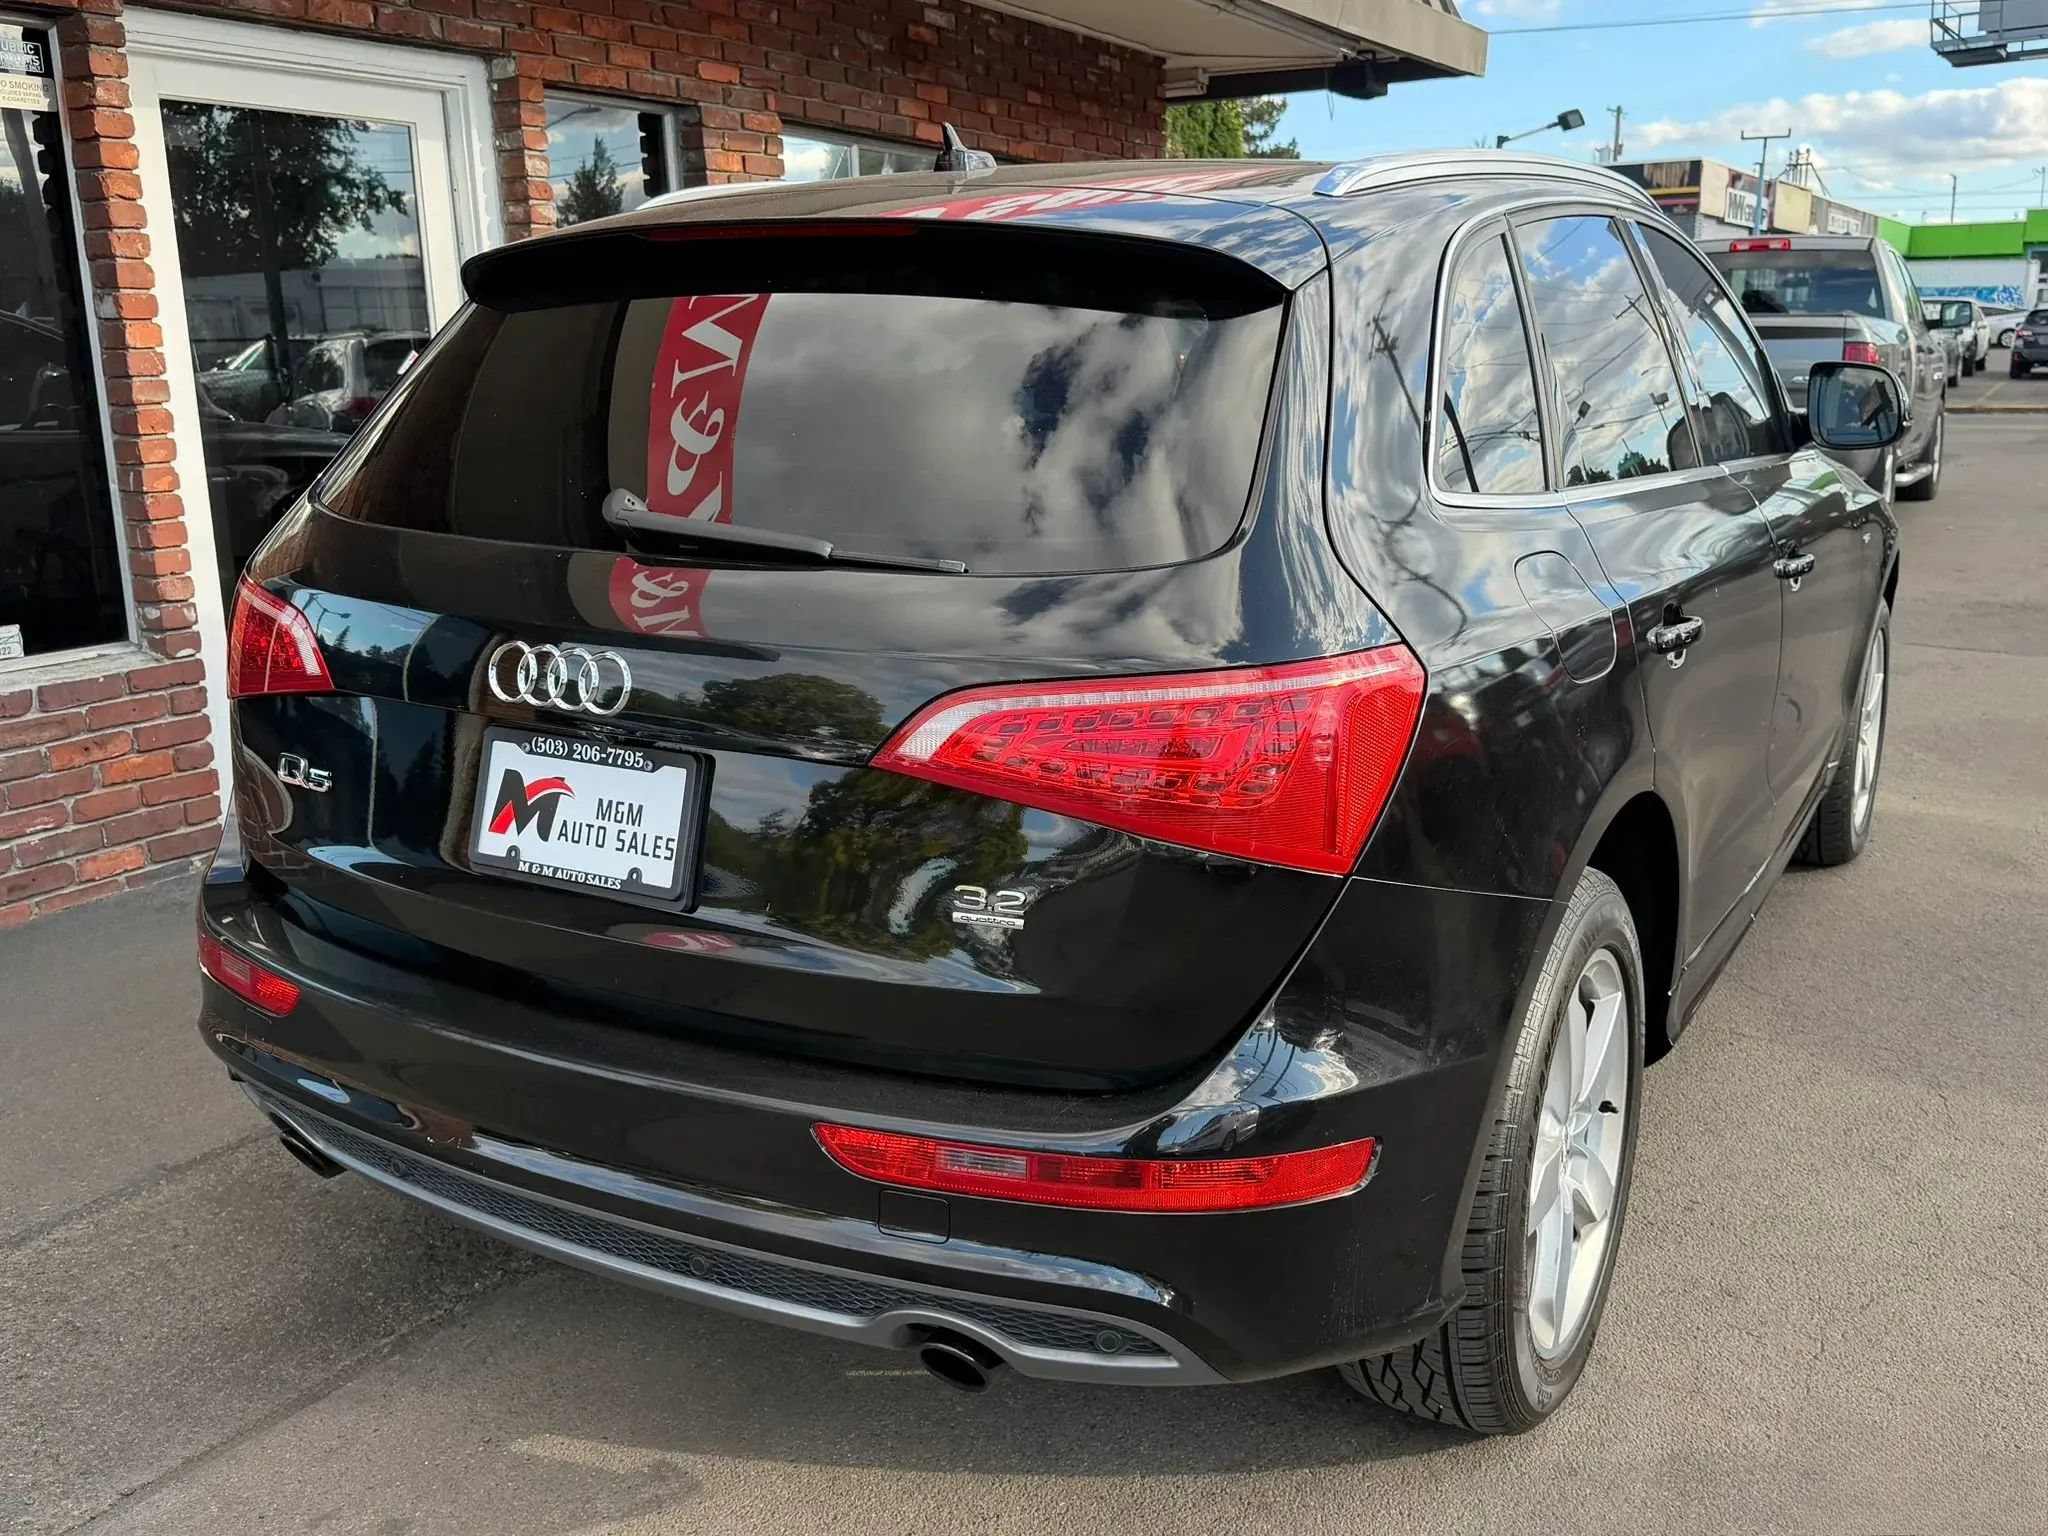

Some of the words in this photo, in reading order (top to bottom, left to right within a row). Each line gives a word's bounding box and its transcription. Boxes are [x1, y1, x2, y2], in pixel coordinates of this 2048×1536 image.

[0, 40, 35, 54] UBLIC
[9, 80, 49, 92] SMOKING
[531, 736, 568, 757] (503)
[572, 742, 644, 769] 206-7795
[277, 751, 333, 793] Q5
[595, 797, 644, 828] M&M
[557, 819, 608, 849] AUTO
[615, 828, 676, 862] SALES
[517, 861, 531, 873] M
[531, 863, 542, 874] &
[542, 865, 554, 878] M
[554, 868, 586, 884] AUTO
[586, 873, 622, 890] SALES
[953, 885, 1027, 916] 3.2
[959, 915, 1016, 926] quattro
